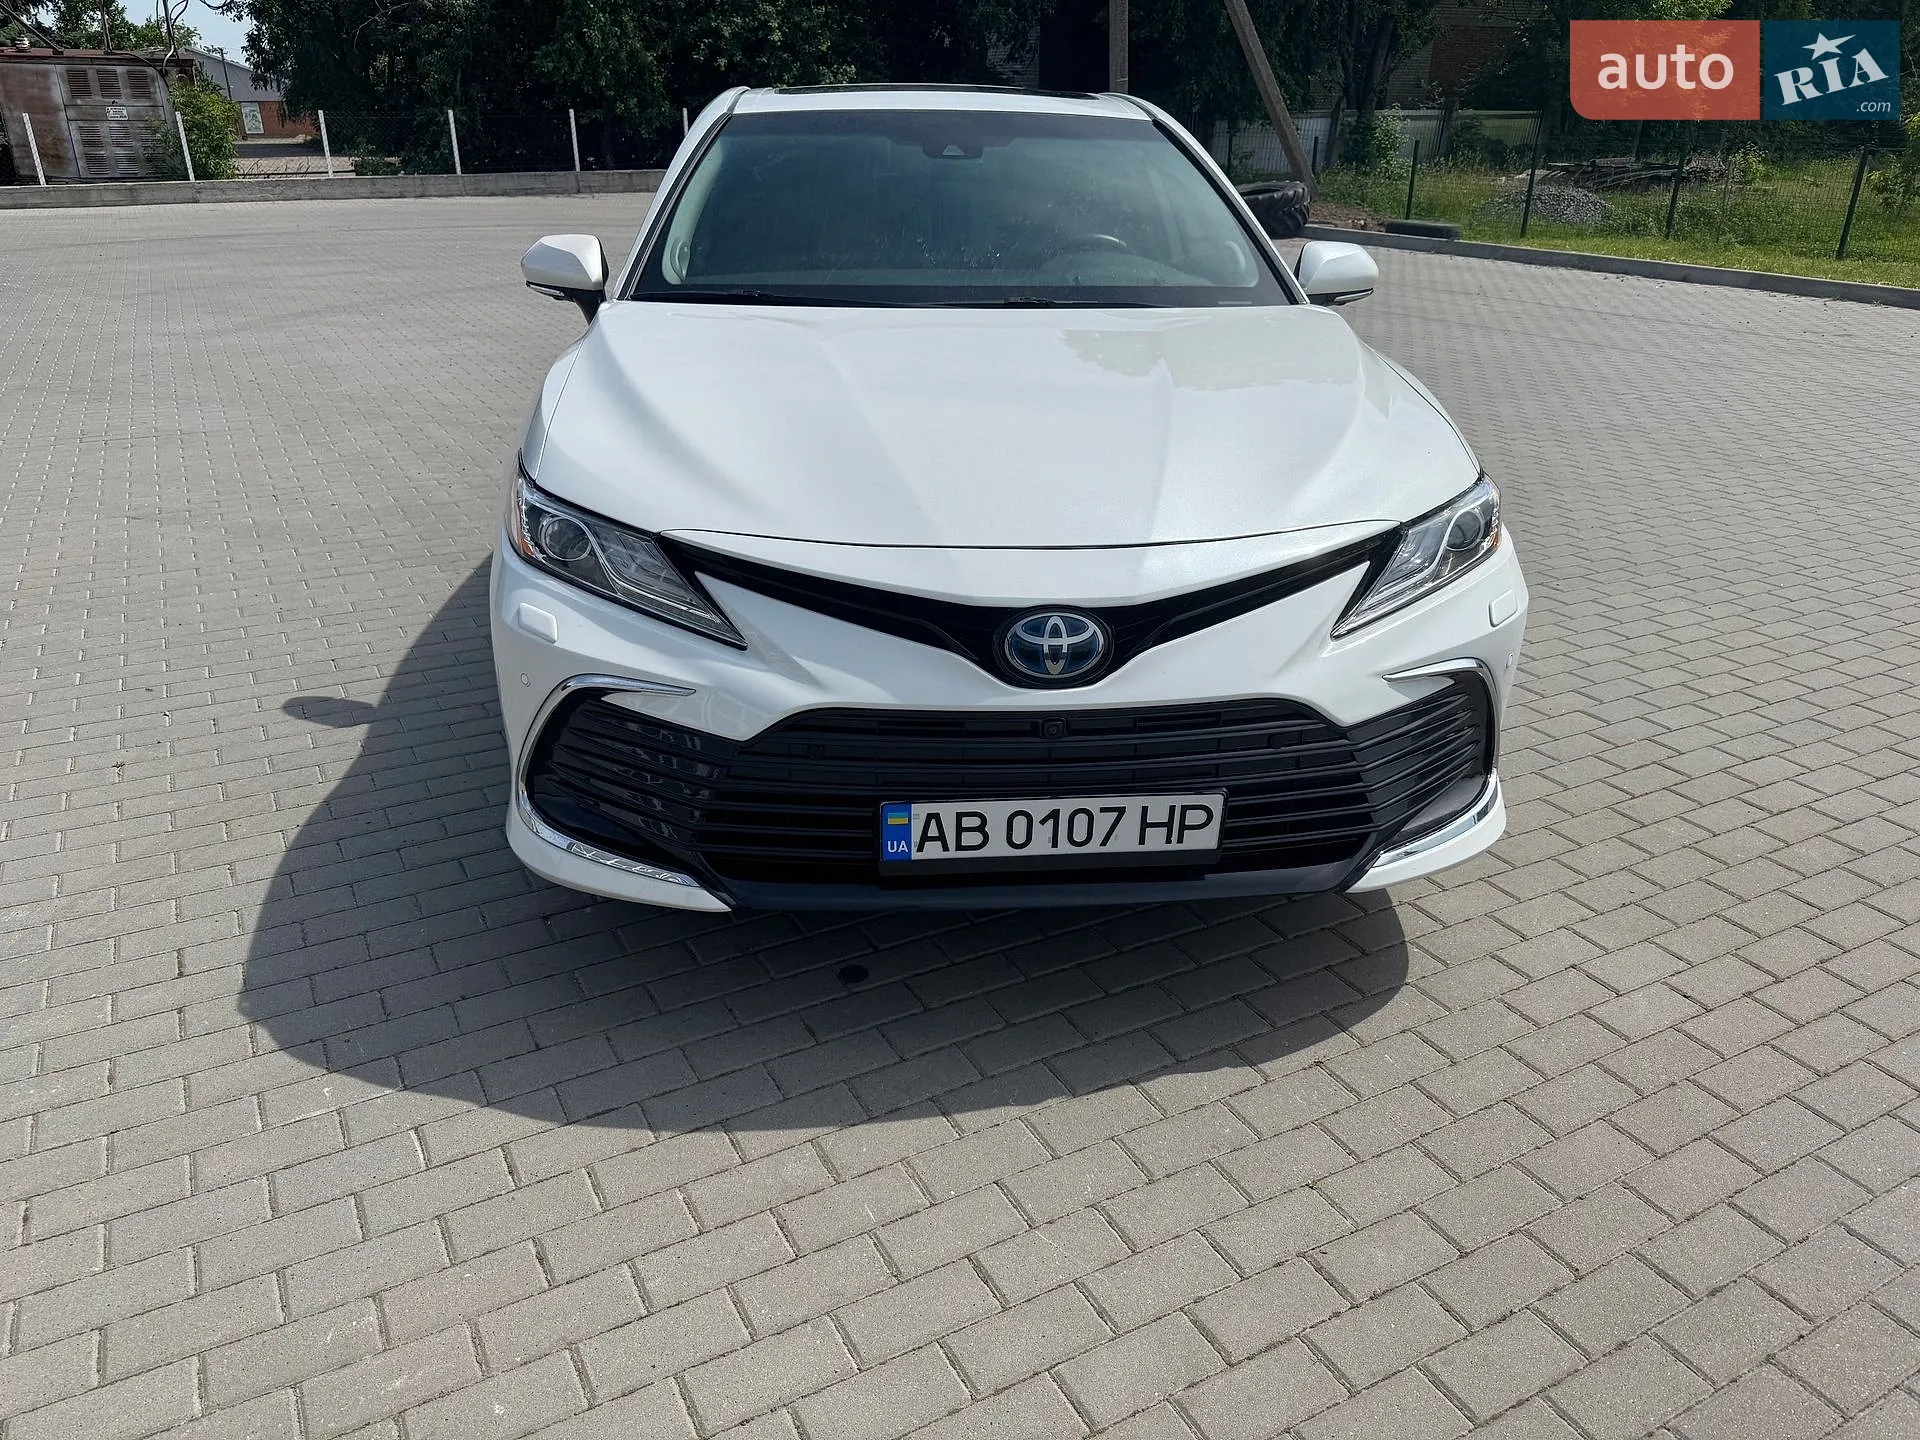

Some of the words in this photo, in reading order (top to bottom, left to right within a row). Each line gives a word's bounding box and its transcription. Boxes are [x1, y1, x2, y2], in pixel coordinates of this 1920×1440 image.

[916, 811, 990, 853] AB
[1006, 806, 1127, 849] 0107
[1138, 804, 1214, 846] HP
[887, 840, 909, 853] UA
